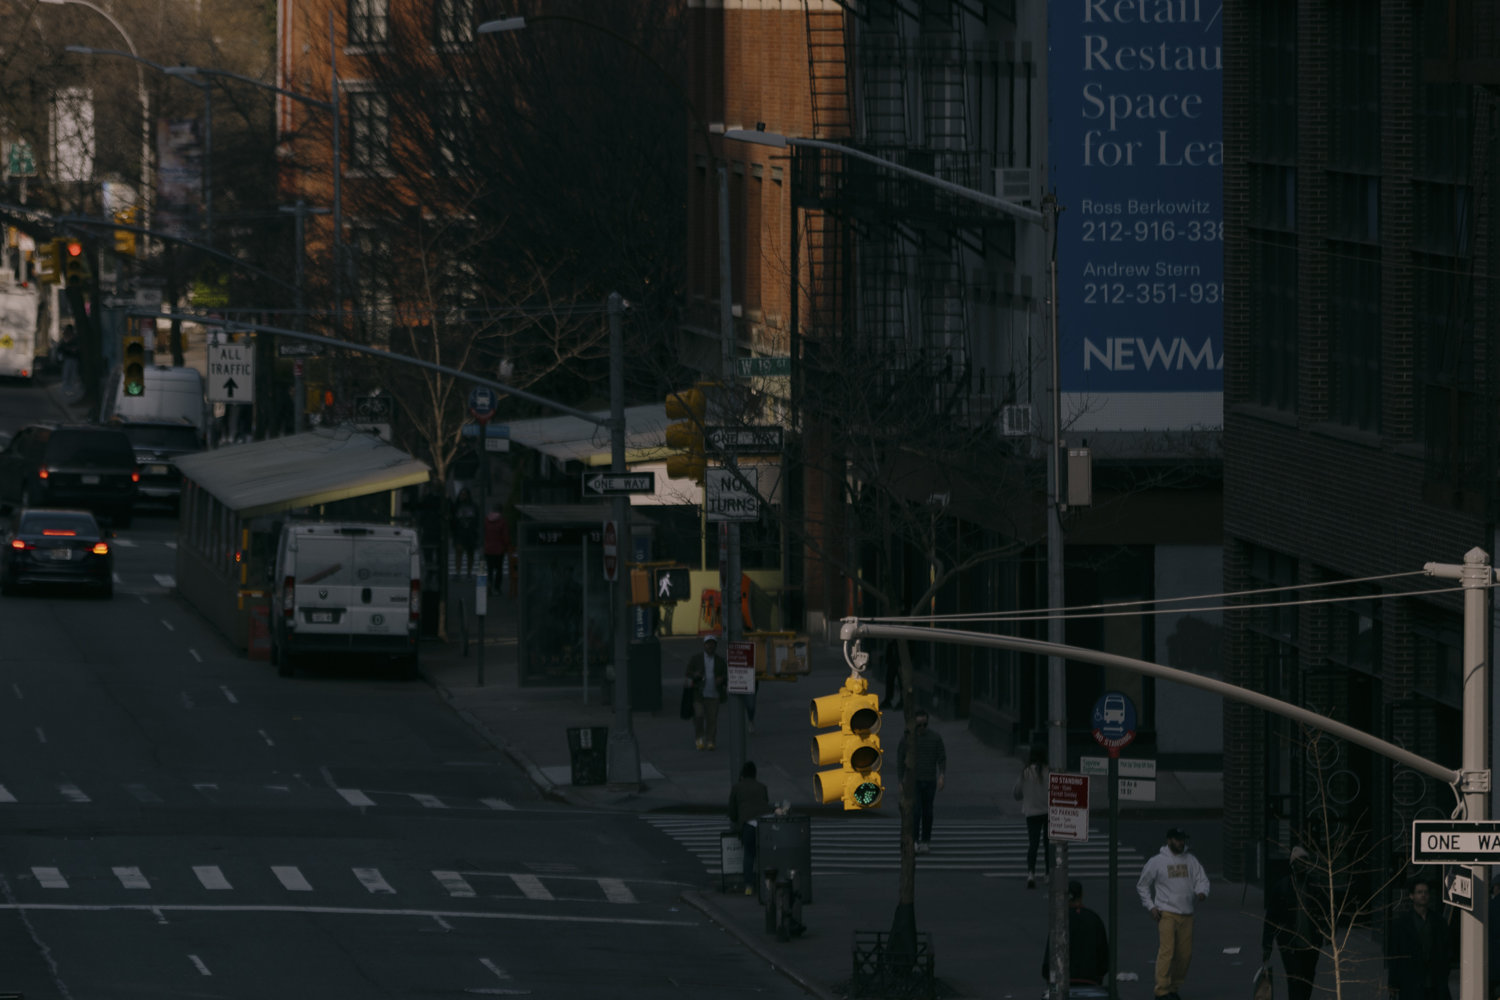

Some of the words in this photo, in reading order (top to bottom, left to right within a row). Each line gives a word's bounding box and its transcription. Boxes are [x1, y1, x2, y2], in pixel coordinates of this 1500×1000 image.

[1082, 83, 1203, 131] Space
[1082, 130, 1142, 166] for
[1157, 130, 1223, 166] Lea
[1082, 199, 1122, 214] Ross
[1128, 199, 1211, 214] Berkowitz
[1083, 262, 1150, 277] Andrew
[1156, 262, 1201, 277] Stern
[1084, 283, 1223, 304] 212-351-93
[220, 349, 241, 360] ALL
[211, 364, 251, 375] TRAFFIC
[741, 360, 752, 375] W
[759, 360, 771, 375] 19
[594, 480, 614, 489] ONE
[624, 480, 645, 489] WAY
[720, 477, 745, 492] NO
[709, 498, 755, 512] TURNS
[1095, 732, 1104, 742] NO
[1104, 733, 1132, 747] STANDING
[1059, 777, 1083, 785] STANDING
[1059, 809, 1079, 817] PARKING
[1427, 834, 1460, 850] ONE
